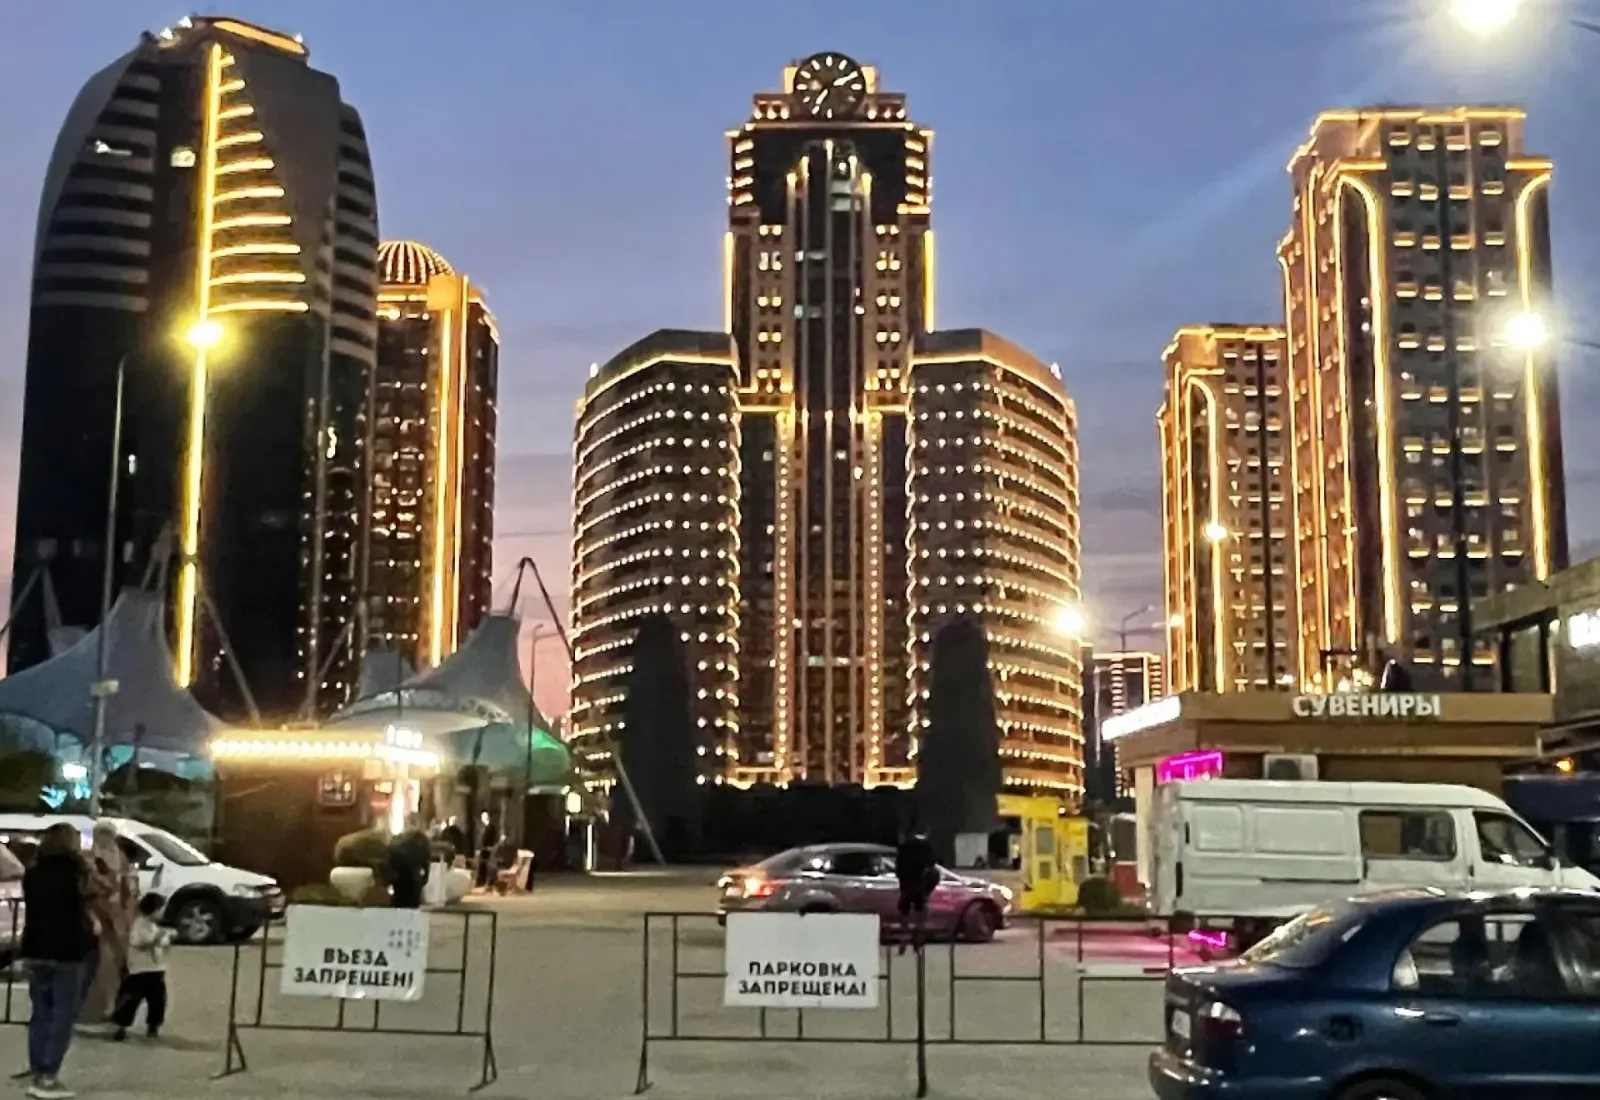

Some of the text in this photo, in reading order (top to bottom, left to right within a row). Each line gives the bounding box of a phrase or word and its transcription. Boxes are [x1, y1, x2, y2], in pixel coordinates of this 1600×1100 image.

[1293, 694, 1441, 717] СУВЕНИРЫ
[294, 967, 414, 988] ЗАПРЕЩЕН!
[749, 961, 857, 977] ПАРКОВКА
[738, 980, 867, 996] ЗАПРЕЩЕНА!
